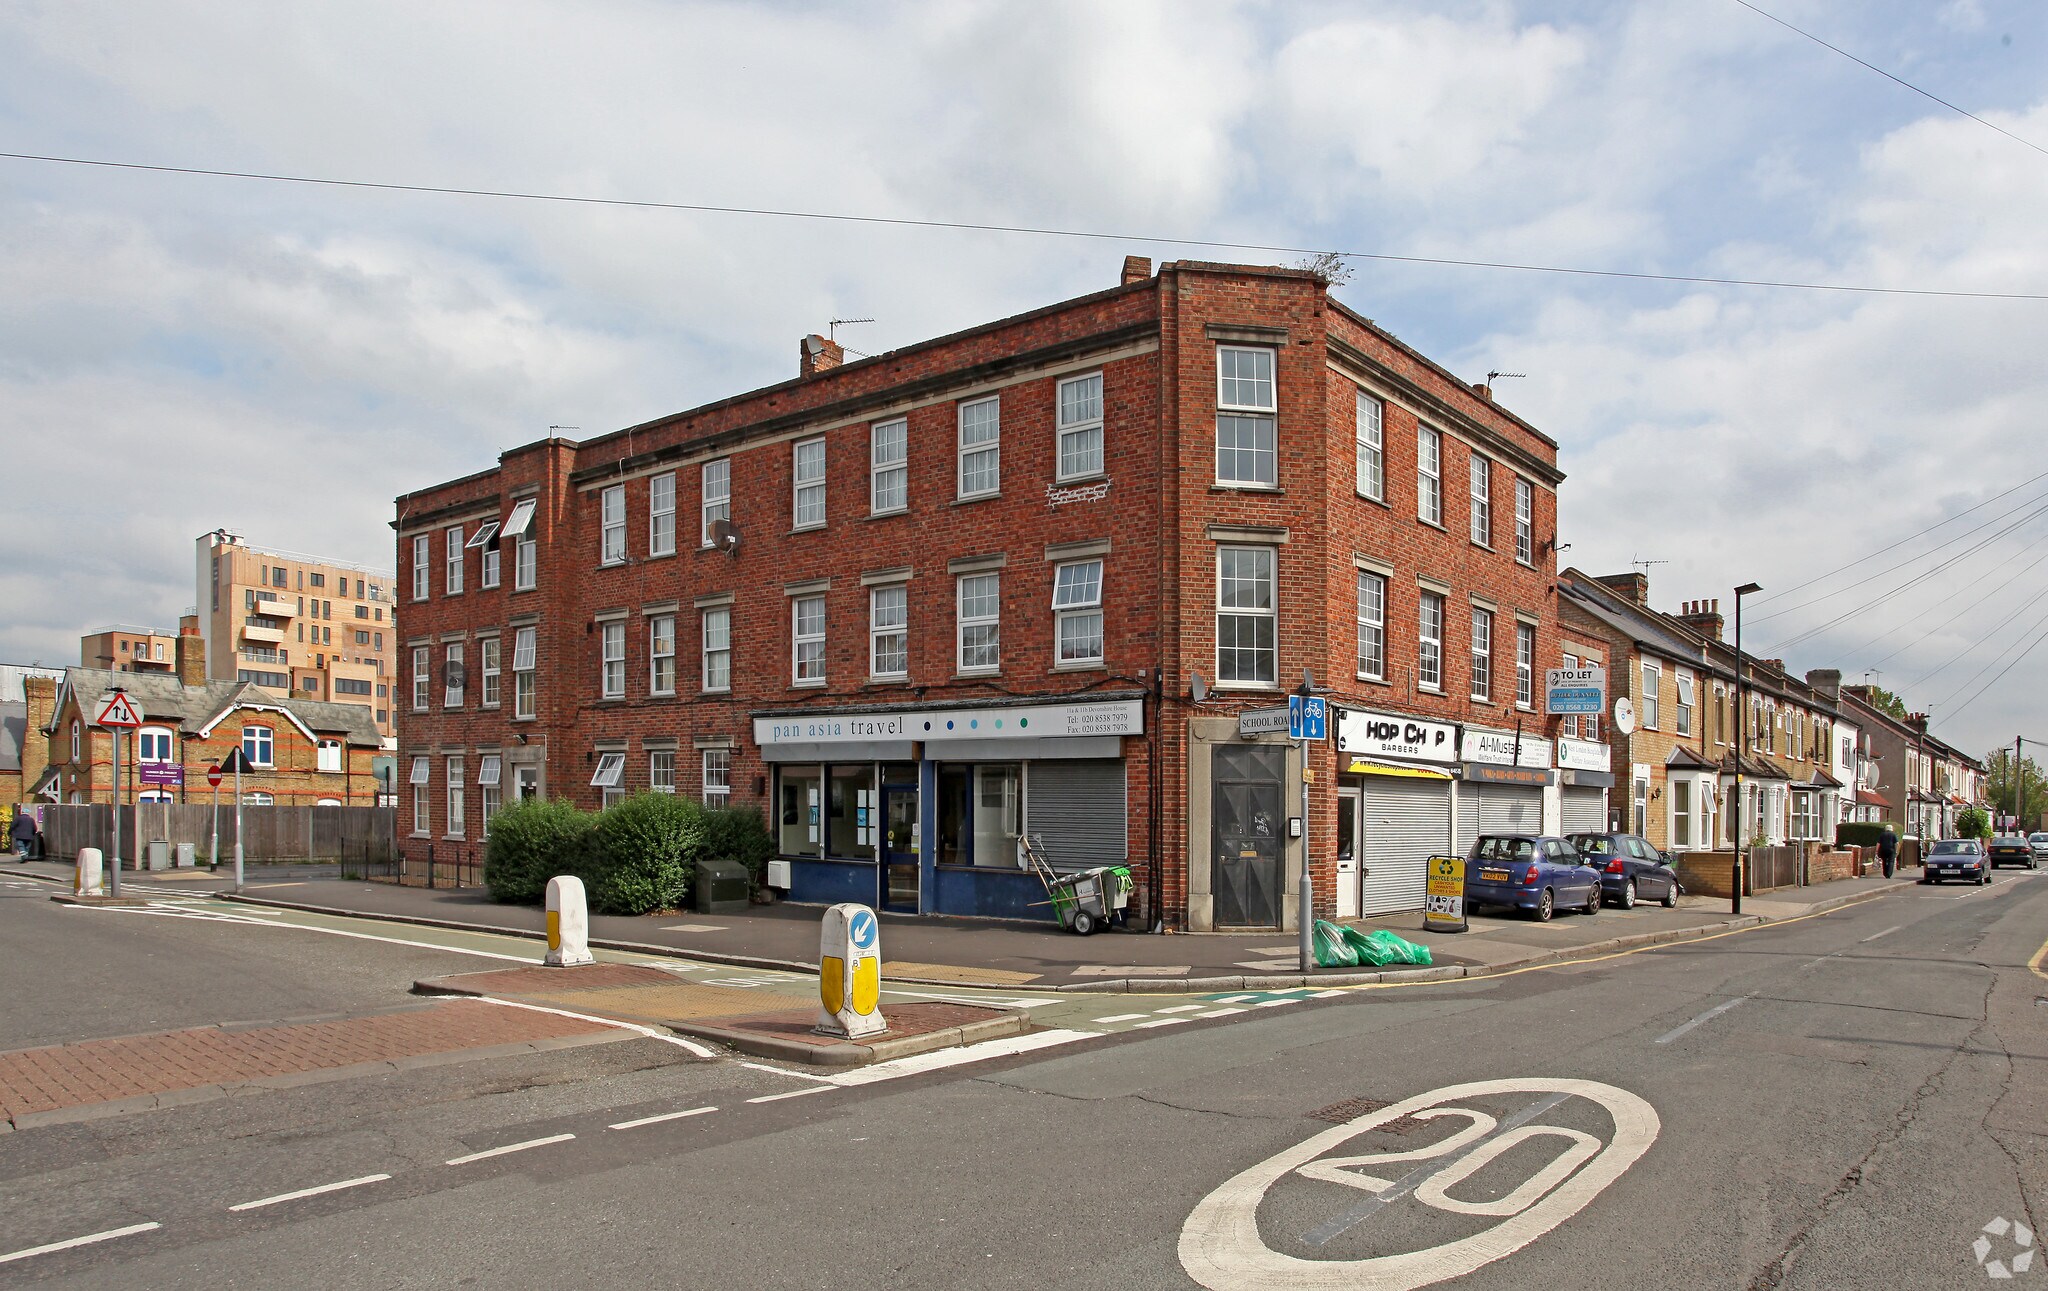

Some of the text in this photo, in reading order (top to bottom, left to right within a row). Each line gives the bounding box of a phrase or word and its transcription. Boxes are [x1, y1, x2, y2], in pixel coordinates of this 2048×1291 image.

[1561, 671, 1592, 679] TO LET
[1067, 713, 1128, 724] Tel: 020 8538 7979
[1242, 715, 1290, 728] SCHOOL ROA
[773, 716, 903, 742] pan asia travel
[1067, 724, 1129, 733] Fax: 020 8538 7978
[1366, 720, 1400, 742] HOP
[1381, 743, 1419, 754] BARBERS
[1479, 736, 1523, 756] Al-Mustaa
[1296, 1107, 1602, 1216] 20
